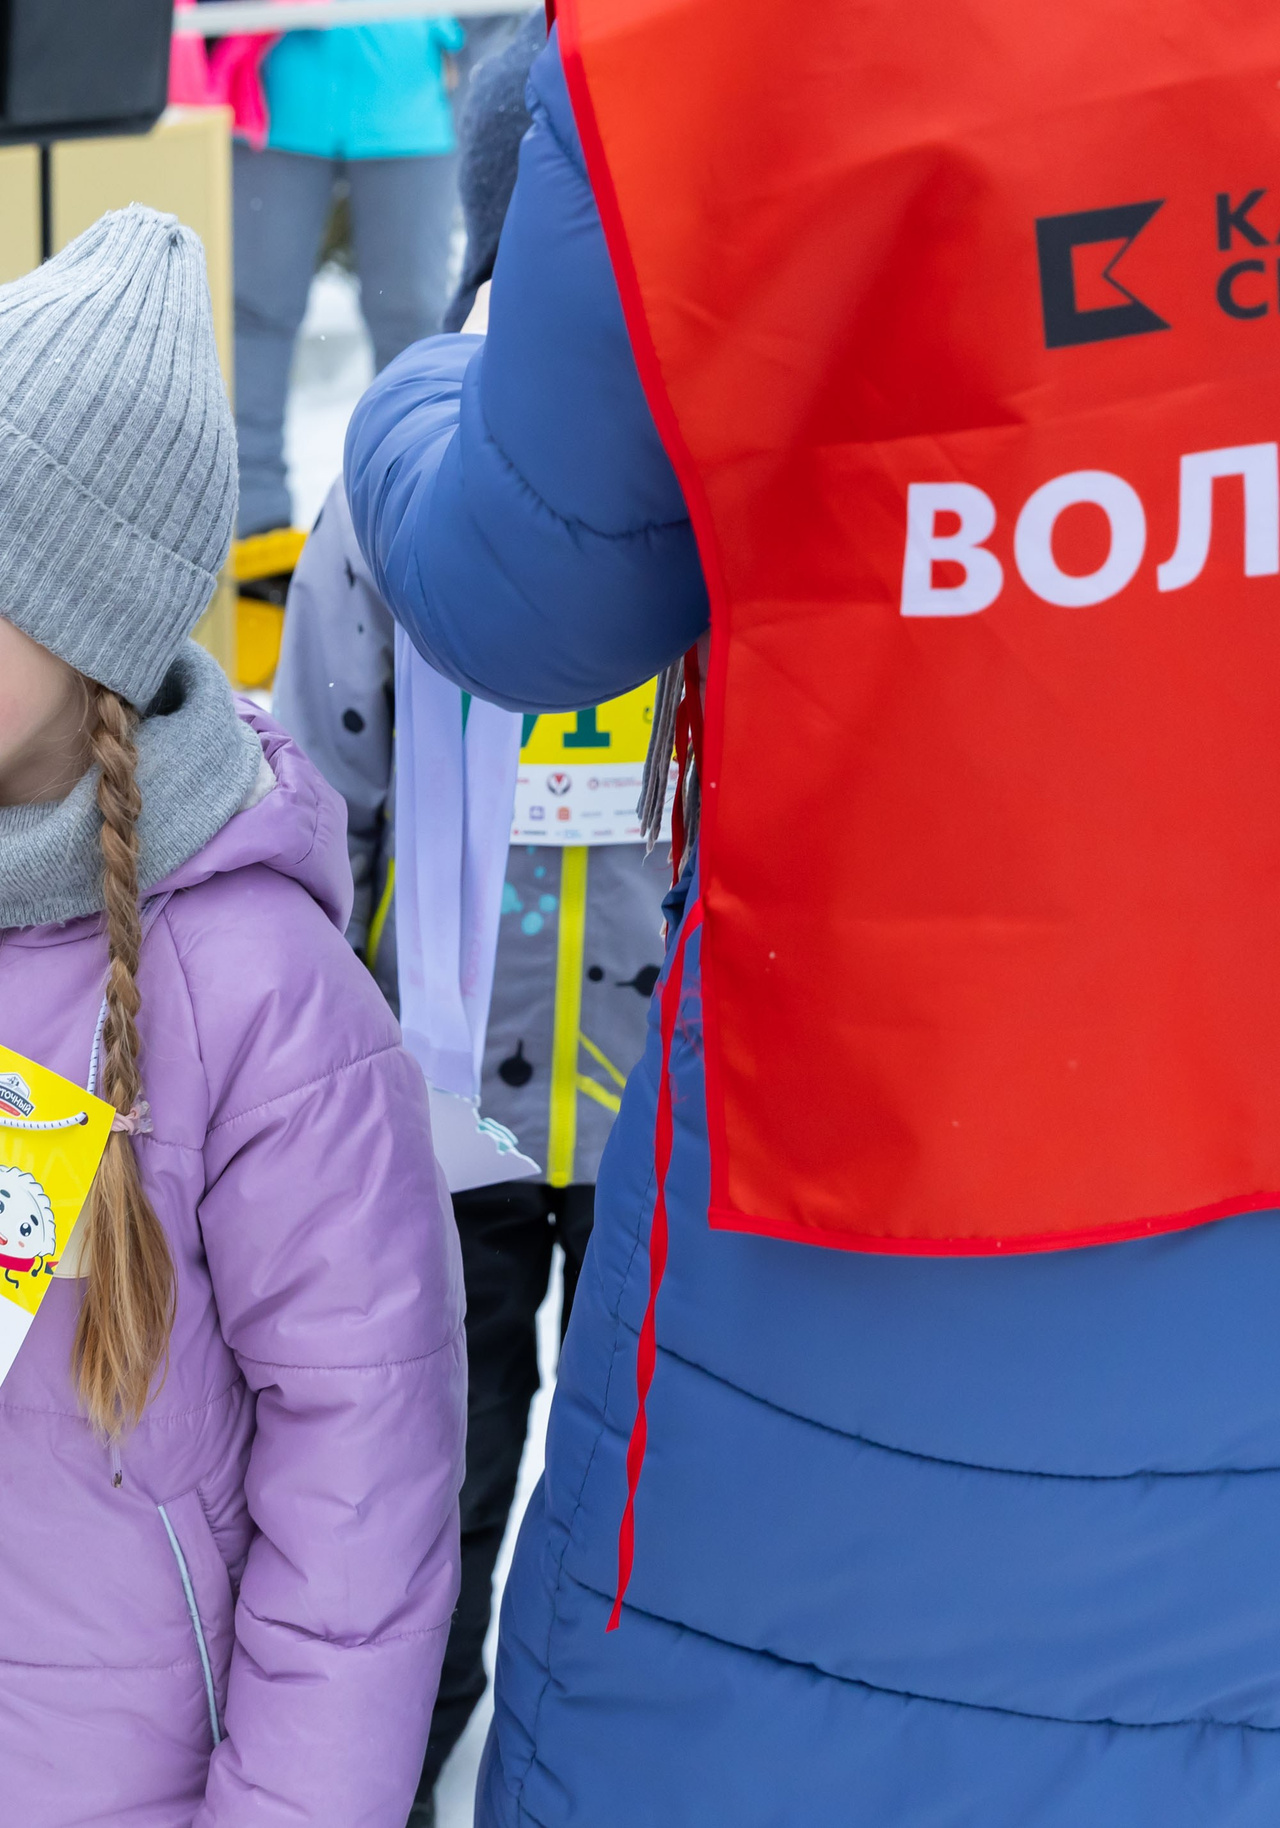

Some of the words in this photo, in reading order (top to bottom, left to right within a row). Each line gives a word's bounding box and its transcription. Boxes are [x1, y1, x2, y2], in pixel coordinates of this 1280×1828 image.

[1216, 188, 1280, 251] К
[1216, 258, 1280, 321] С
[900, 442, 1280, 617] ВОЛ
